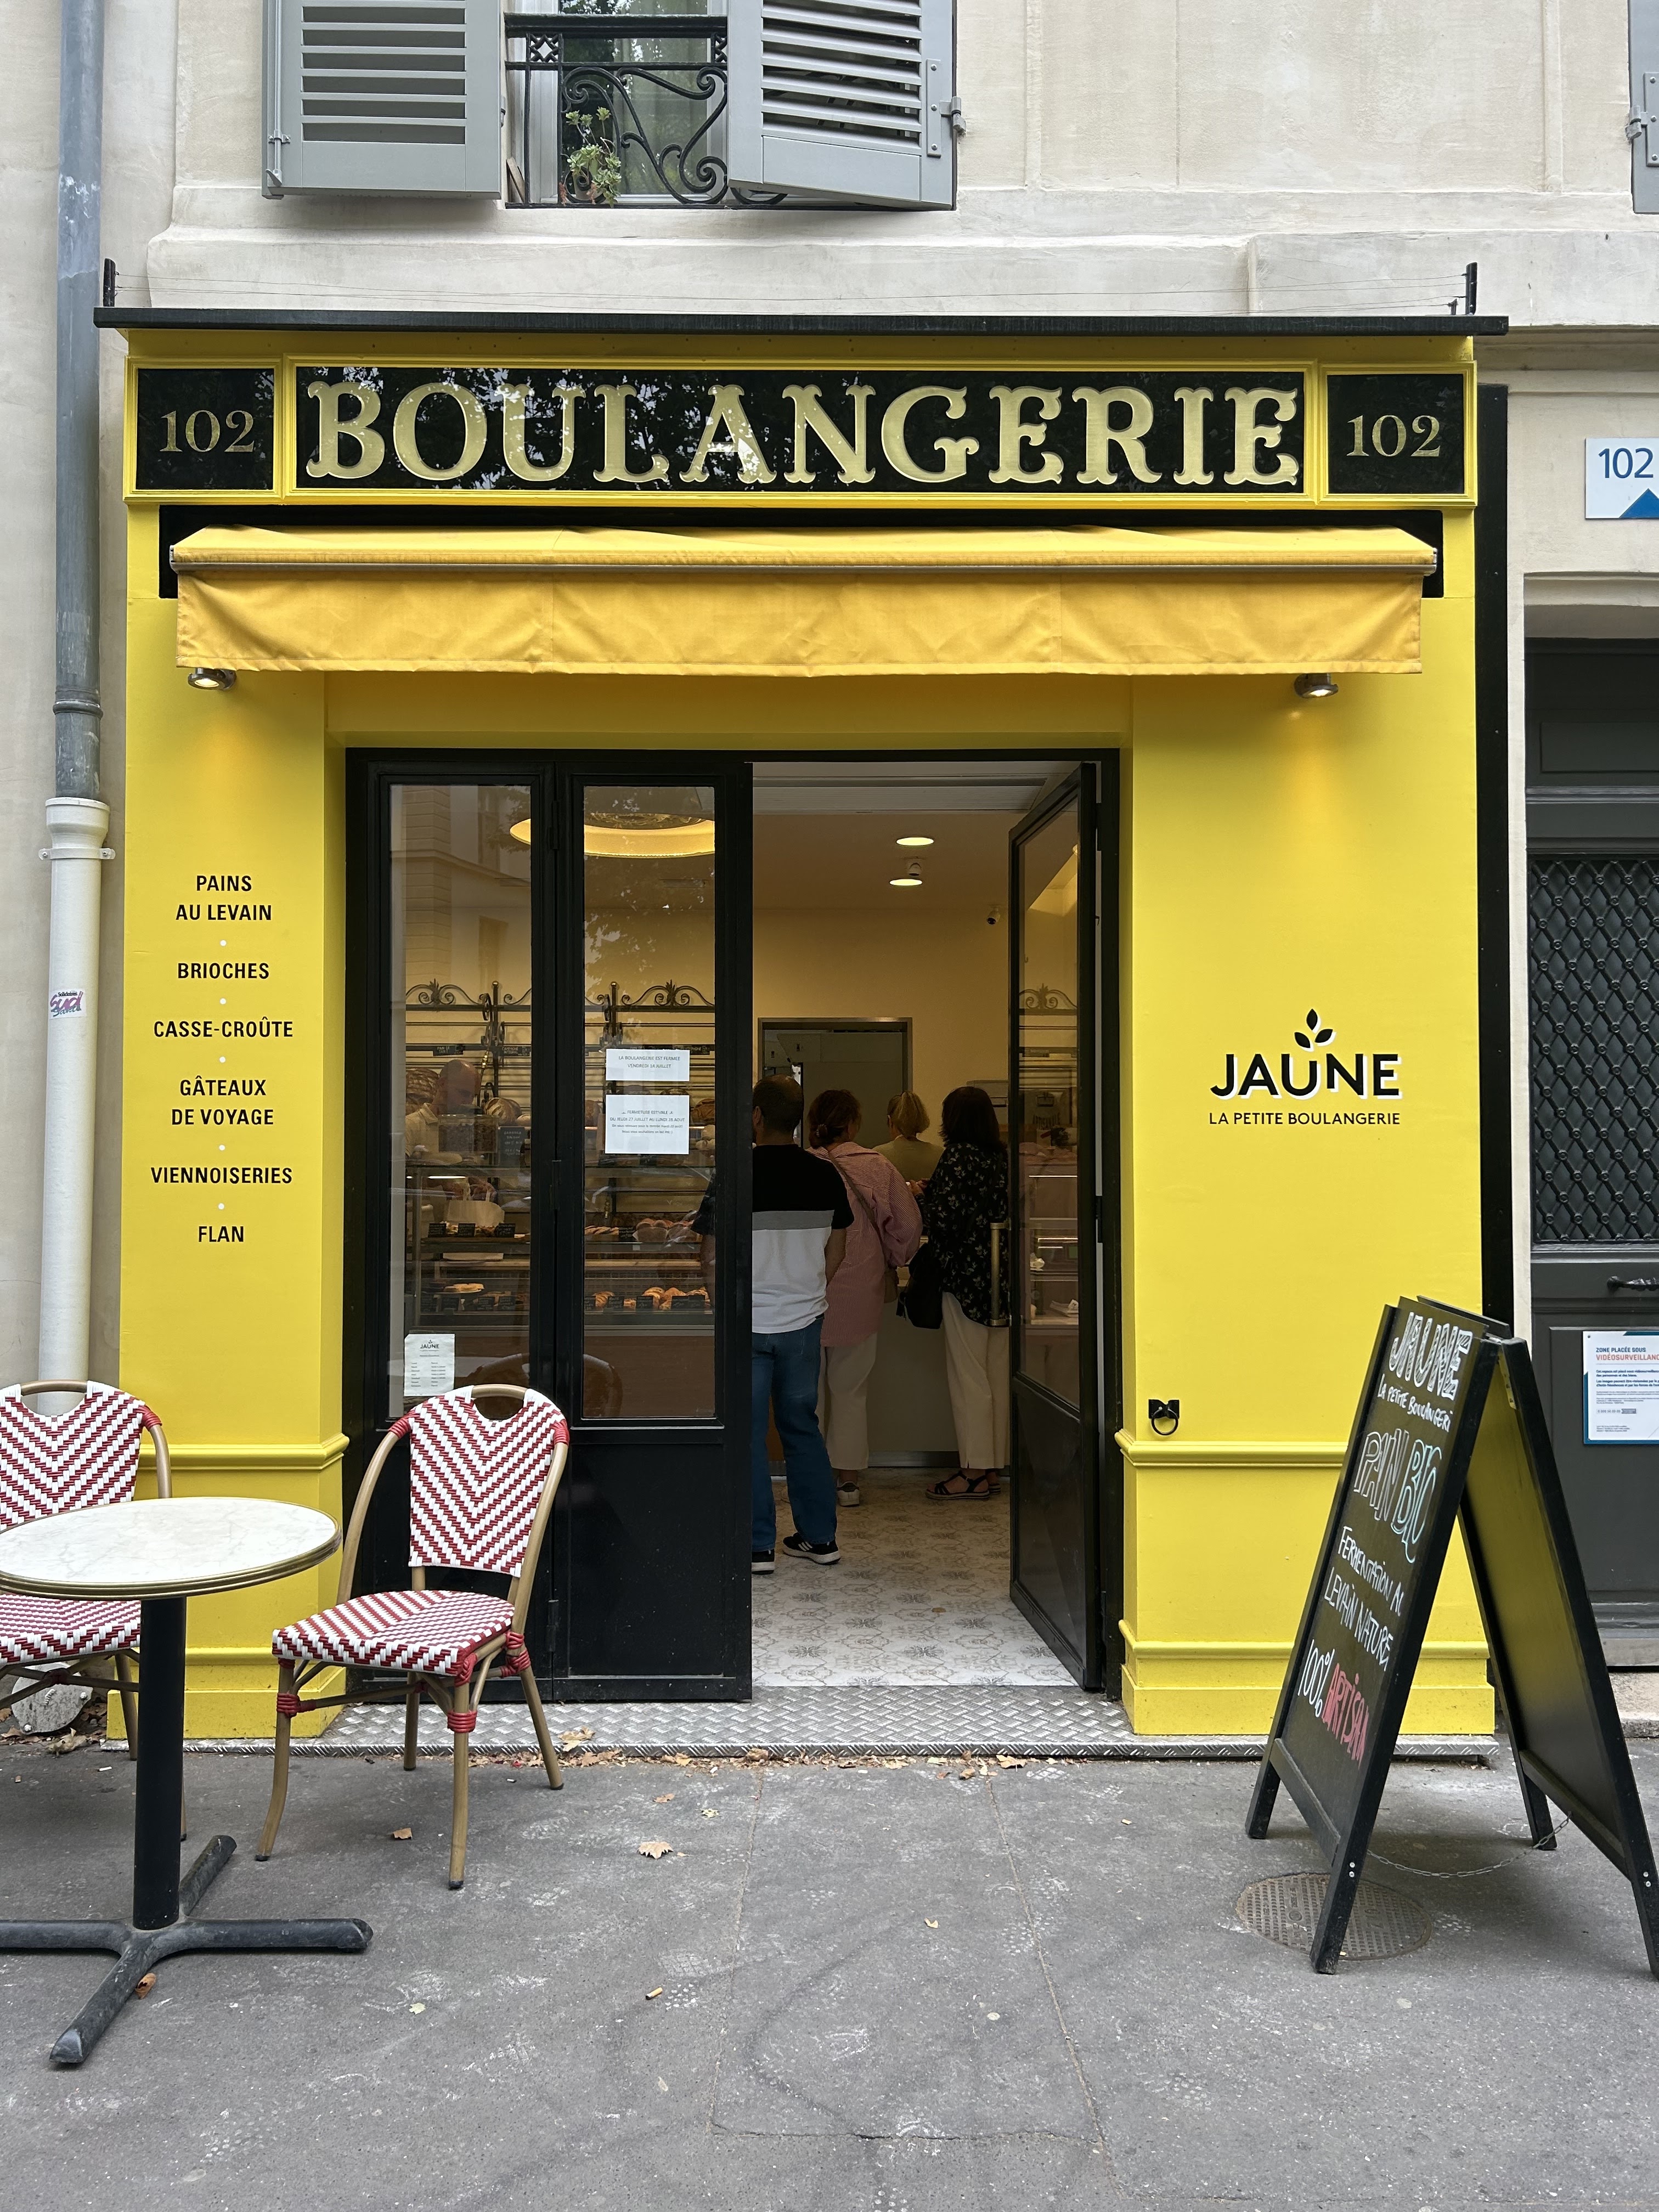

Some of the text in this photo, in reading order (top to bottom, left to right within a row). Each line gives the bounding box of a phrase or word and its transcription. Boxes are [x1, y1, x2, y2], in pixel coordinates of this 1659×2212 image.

[160, 410, 254, 452] 102
[306, 381, 1299, 486] BOULANGERIE
[1346, 415, 1441, 456] 102
[1599, 448, 1654, 478] 102
[196, 875, 252, 891] PAINS
[176, 904, 272, 921] AU LEVAIN
[178, 962, 269, 979] BRIOCHES
[154, 1016, 293, 1037] CASSE-CROÛTE
[180, 1075, 266, 1096] GÂTEAUX
[1210, 1053, 1402, 1099] JAUNE
[172, 1109, 274, 1125] DE VOYAGE
[1209, 1112, 1400, 1125] LA PETITE BOULANGERIE
[150, 1167, 292, 1184] VIENNOISERIES
[198, 1226, 244, 1243] FLAN
[1389, 1312, 1472, 1401] JAUNE
[1378, 1373, 1387, 1399] LA
[1387, 1386, 1409, 1408] PETITE
[1353, 1428, 1409, 1521] PAIN
[1297, 1639, 1335, 1718] 100%
